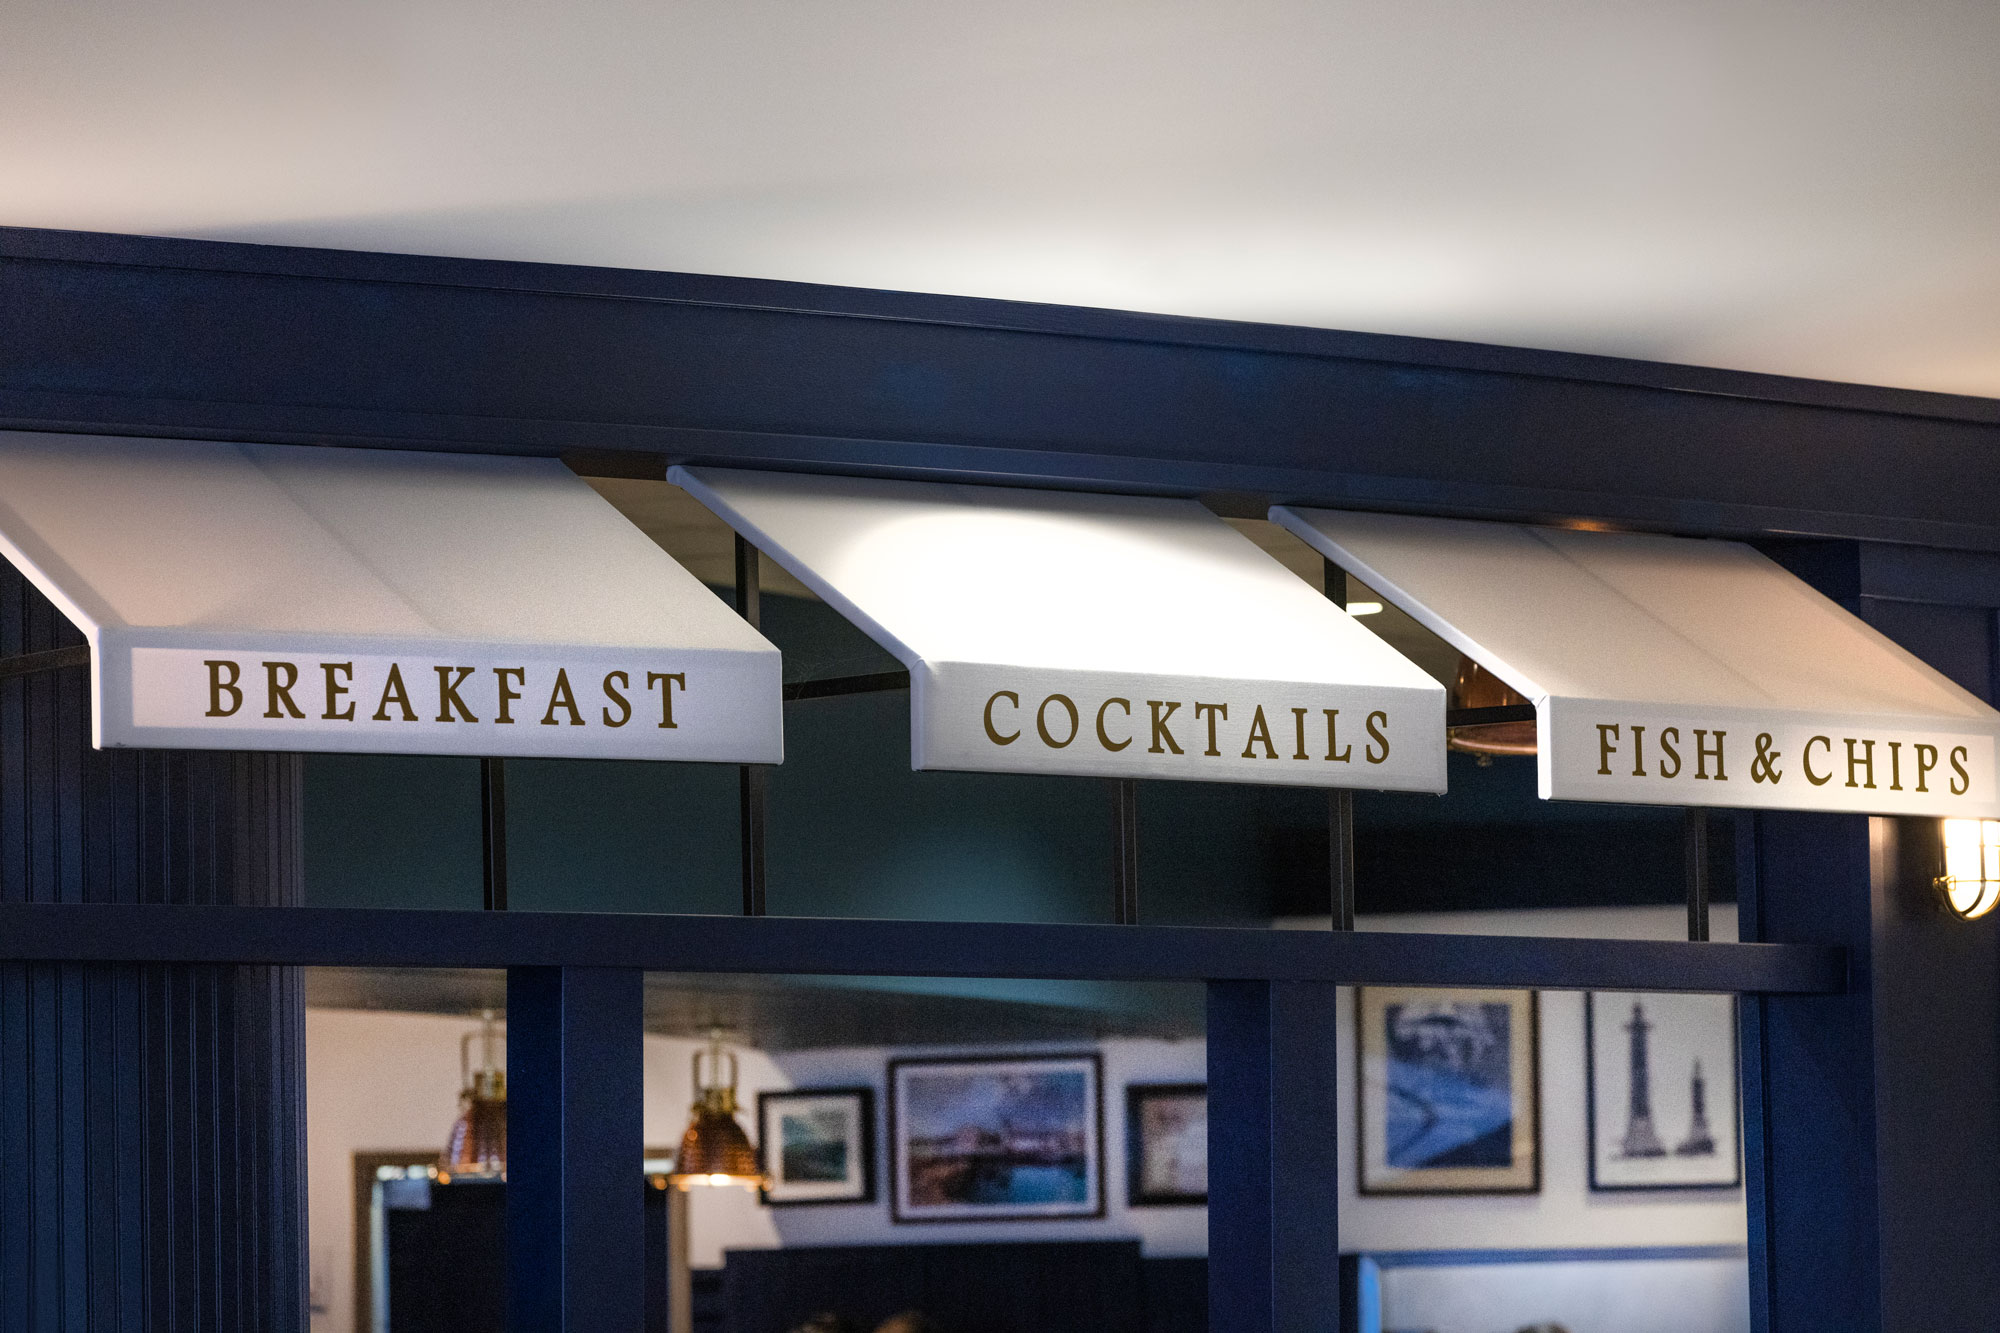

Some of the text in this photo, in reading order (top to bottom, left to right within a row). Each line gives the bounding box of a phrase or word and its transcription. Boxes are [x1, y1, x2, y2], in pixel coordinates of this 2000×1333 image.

[204, 660, 686, 730] BREAKFAST
[984, 690, 1390, 765] COCKTAILS
[1596, 723, 1970, 796] FISH & CHIPS
